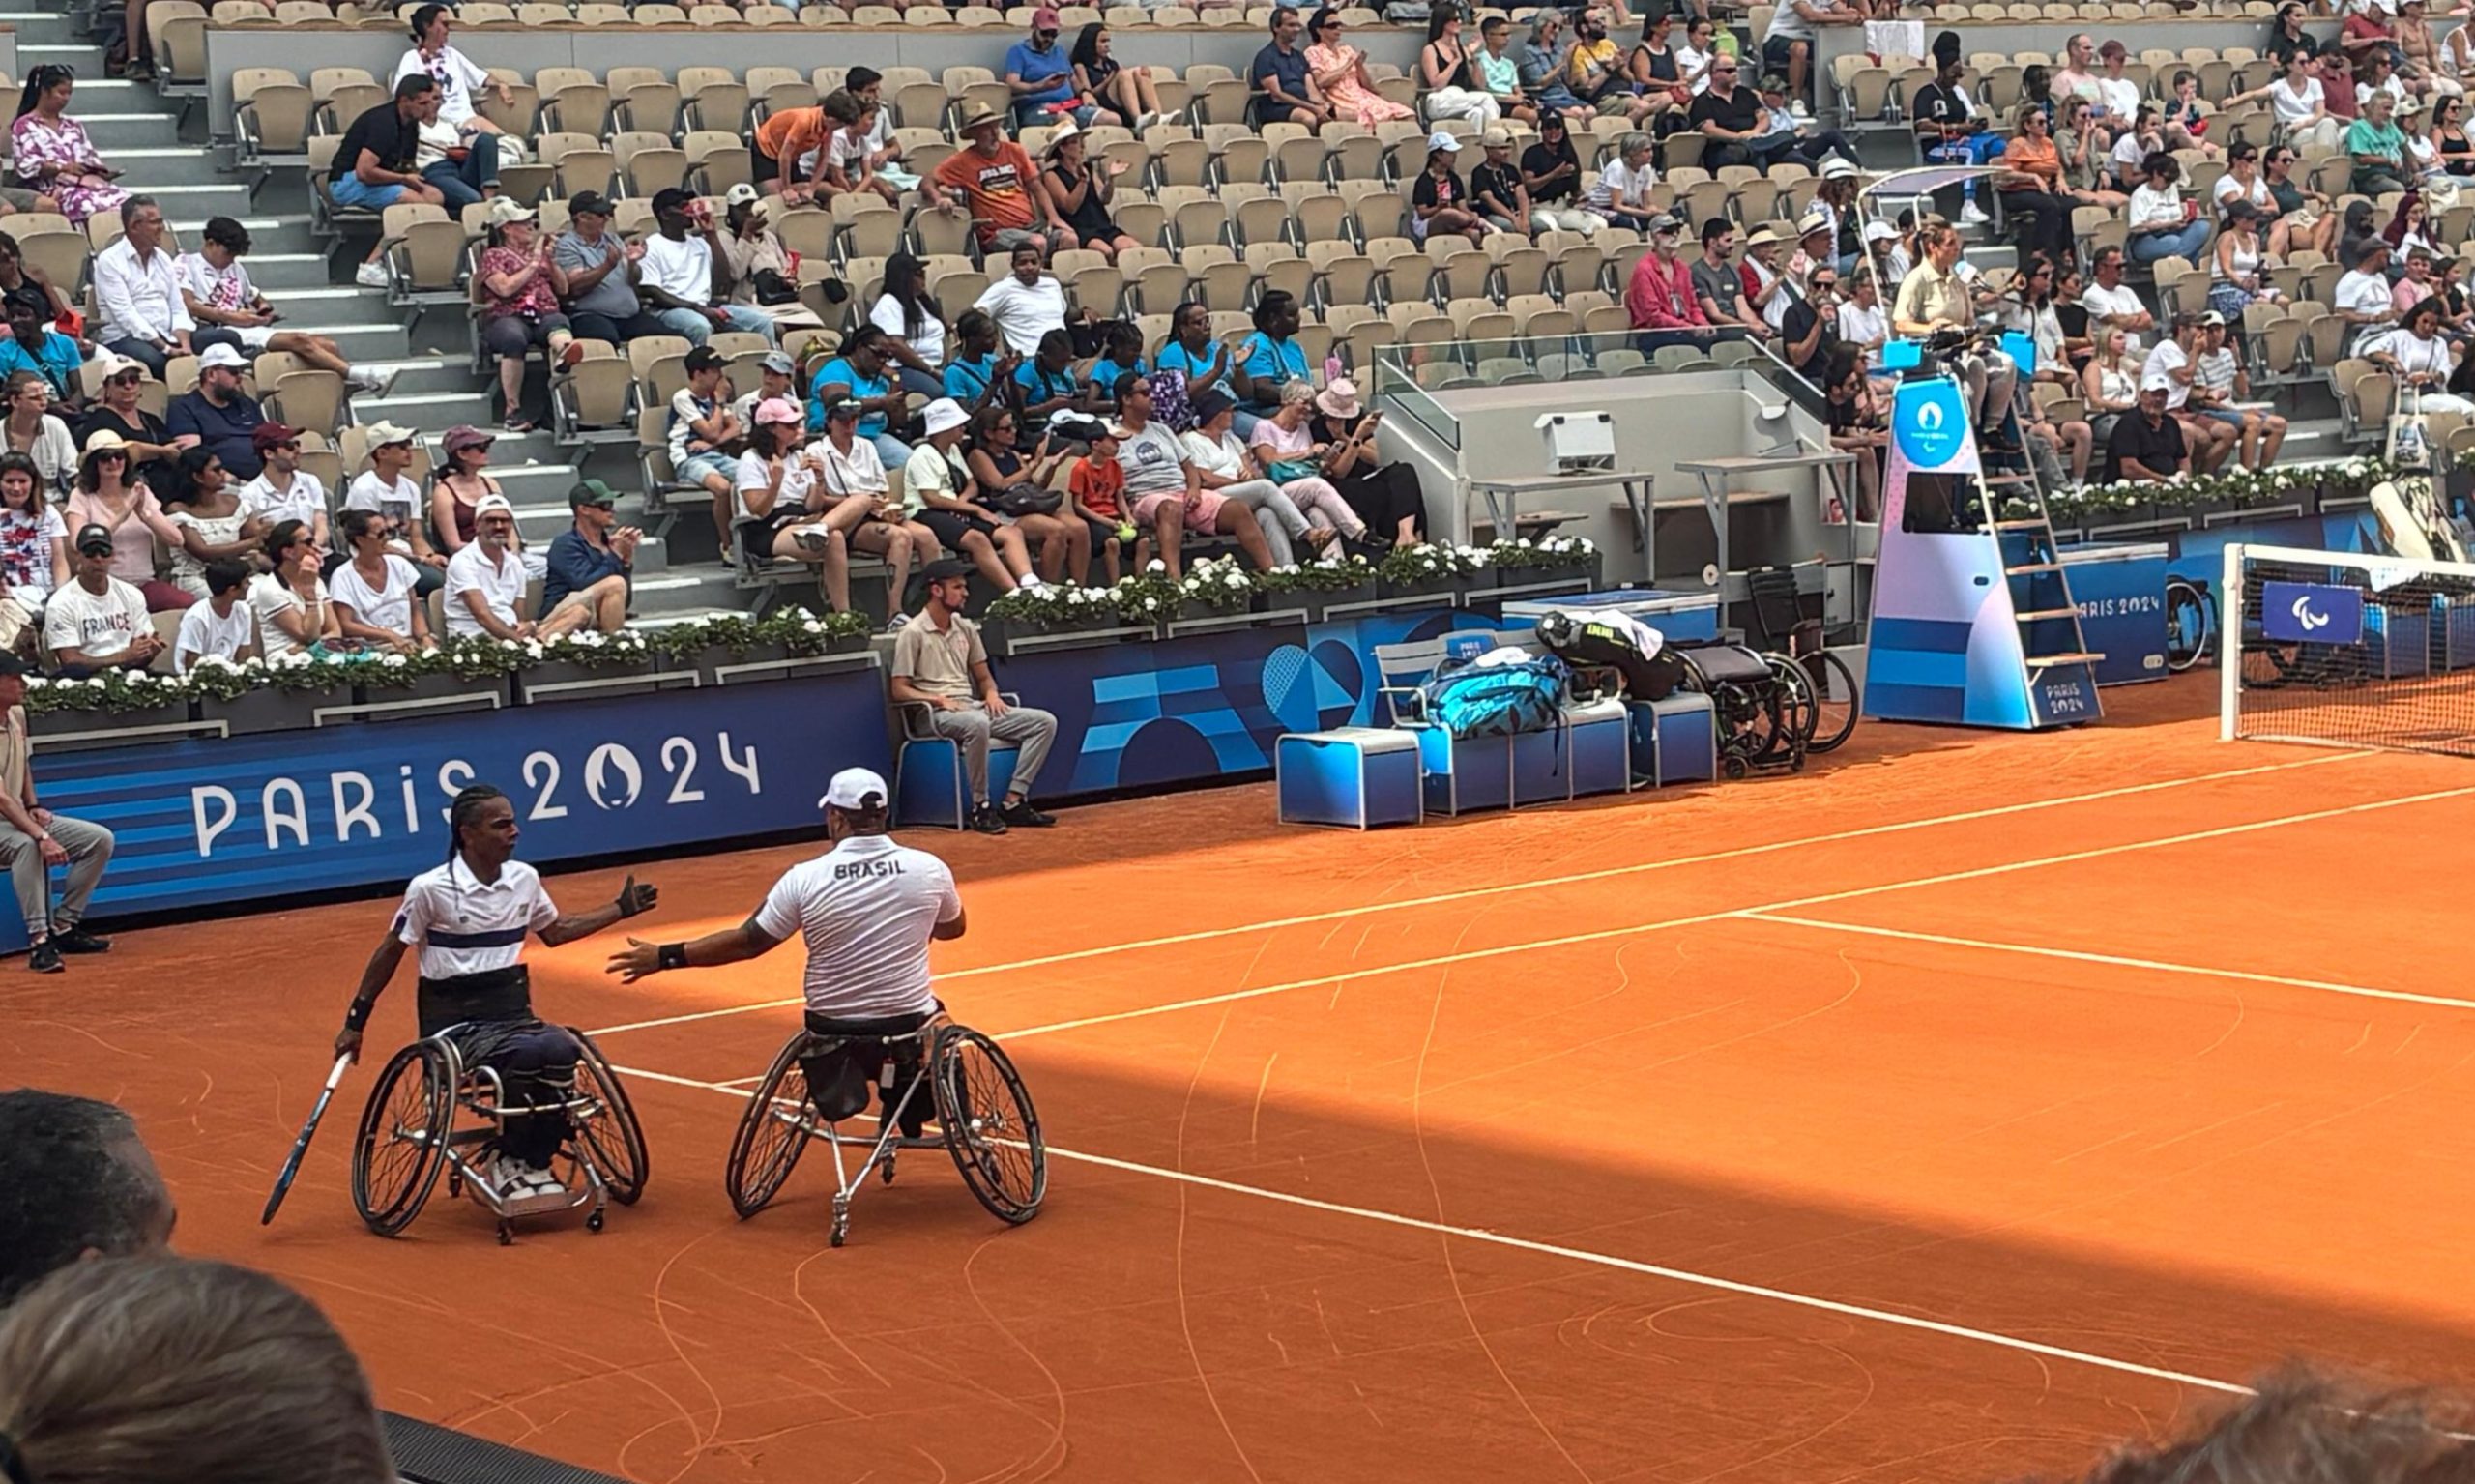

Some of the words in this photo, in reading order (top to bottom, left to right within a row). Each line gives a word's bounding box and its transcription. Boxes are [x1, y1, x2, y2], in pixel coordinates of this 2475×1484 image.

[2080, 599, 2113, 618] ARIS
[2119, 597, 2159, 614] 2024
[82, 612, 131, 638] FRANCE
[2046, 683, 2080, 699] PARIS
[2050, 699, 2083, 714] 2024
[522, 731, 761, 821] 2024
[834, 859, 907, 880] BRASIL
